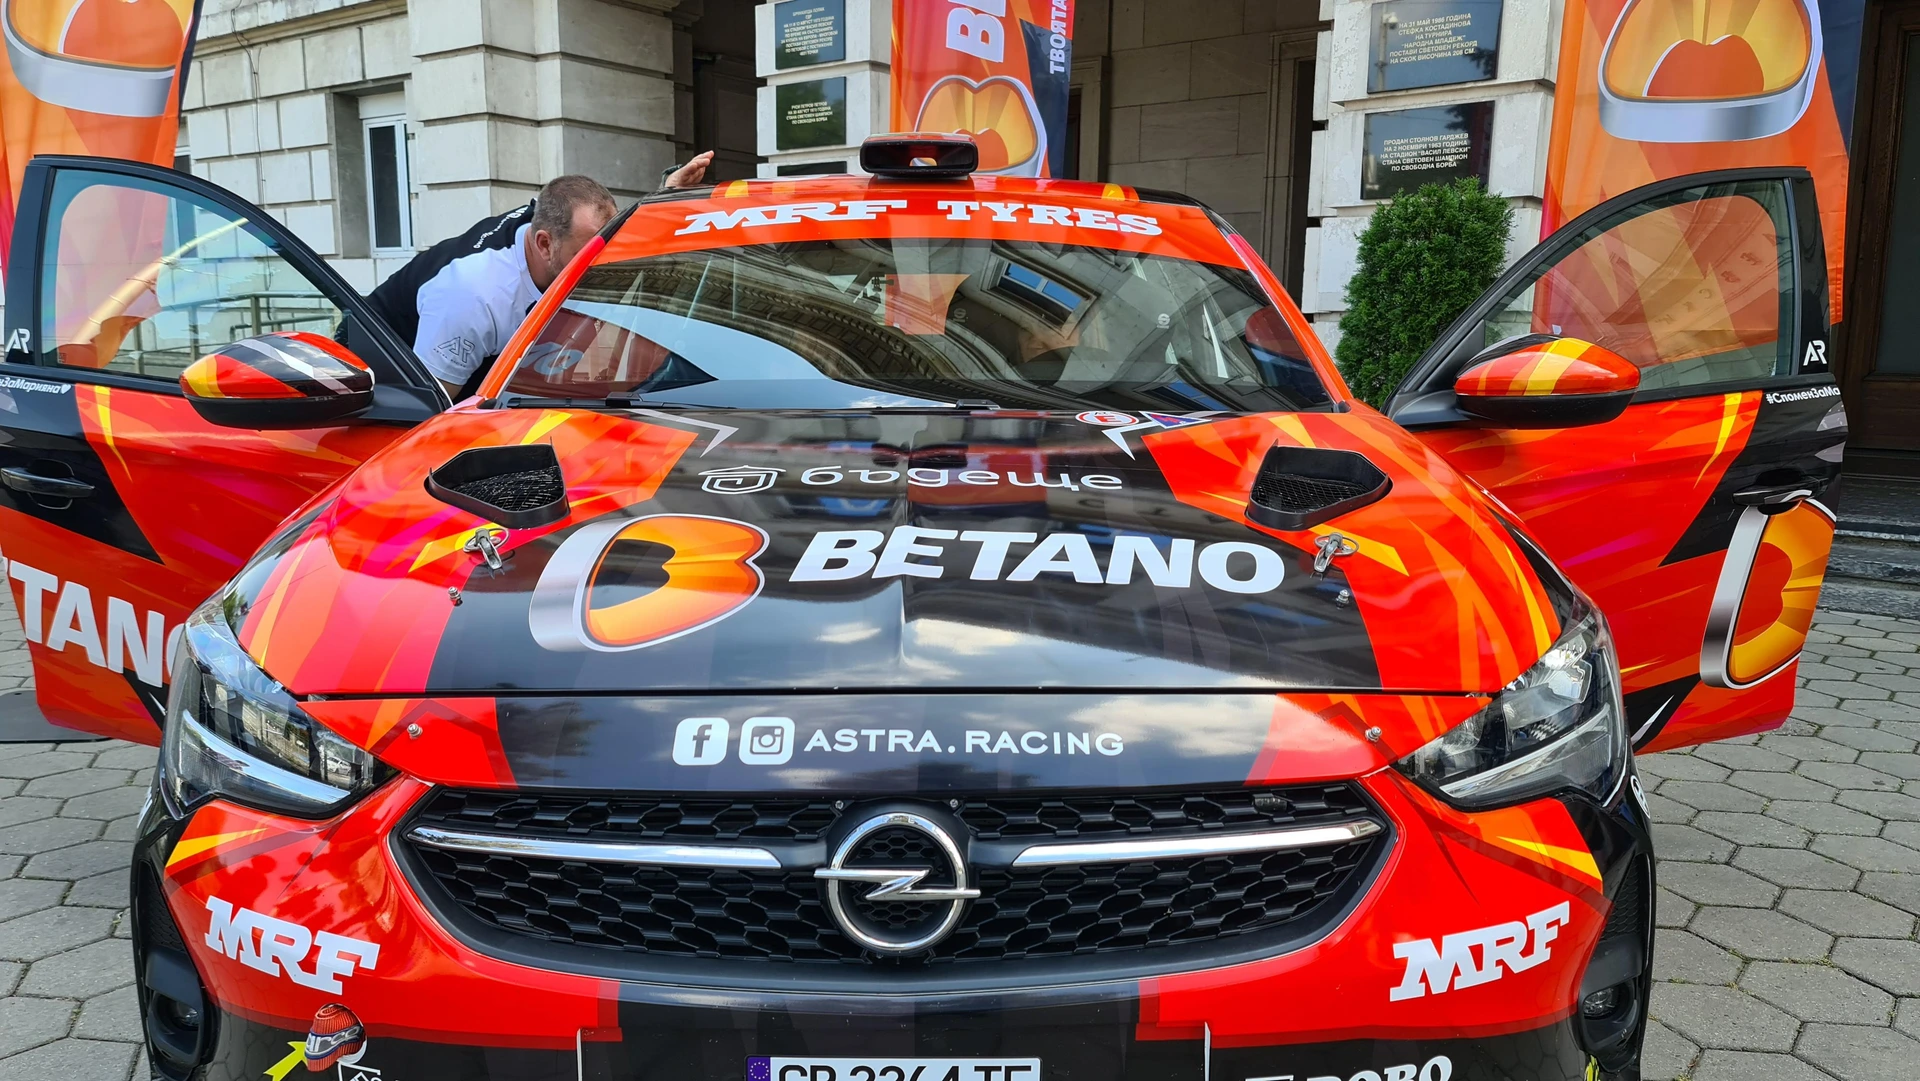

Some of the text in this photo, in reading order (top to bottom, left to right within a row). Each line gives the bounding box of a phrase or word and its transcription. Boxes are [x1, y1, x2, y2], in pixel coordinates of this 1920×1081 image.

[946, 0, 1007, 63] B
[1384, 138, 1409, 146] ПРОДАН
[1409, 135, 1438, 143] СТОЯНОВ
[1442, 140, 1468, 148] ГОДИНА
[1401, 163, 1435, 171] СВОБОДНА
[1402, 156, 1434, 164] СВЕТОВЕН
[674, 199, 1163, 236] MRF TYRES
[5, 328, 31, 354] AR
[1802, 340, 1828, 366] AR
[789, 524, 1286, 594] BETANO
[2, 556, 185, 688] TAN
[803, 729, 1125, 757] ASTRA.RACING
[204, 895, 381, 996] MRF
[1389, 900, 1570, 1002] MRF
